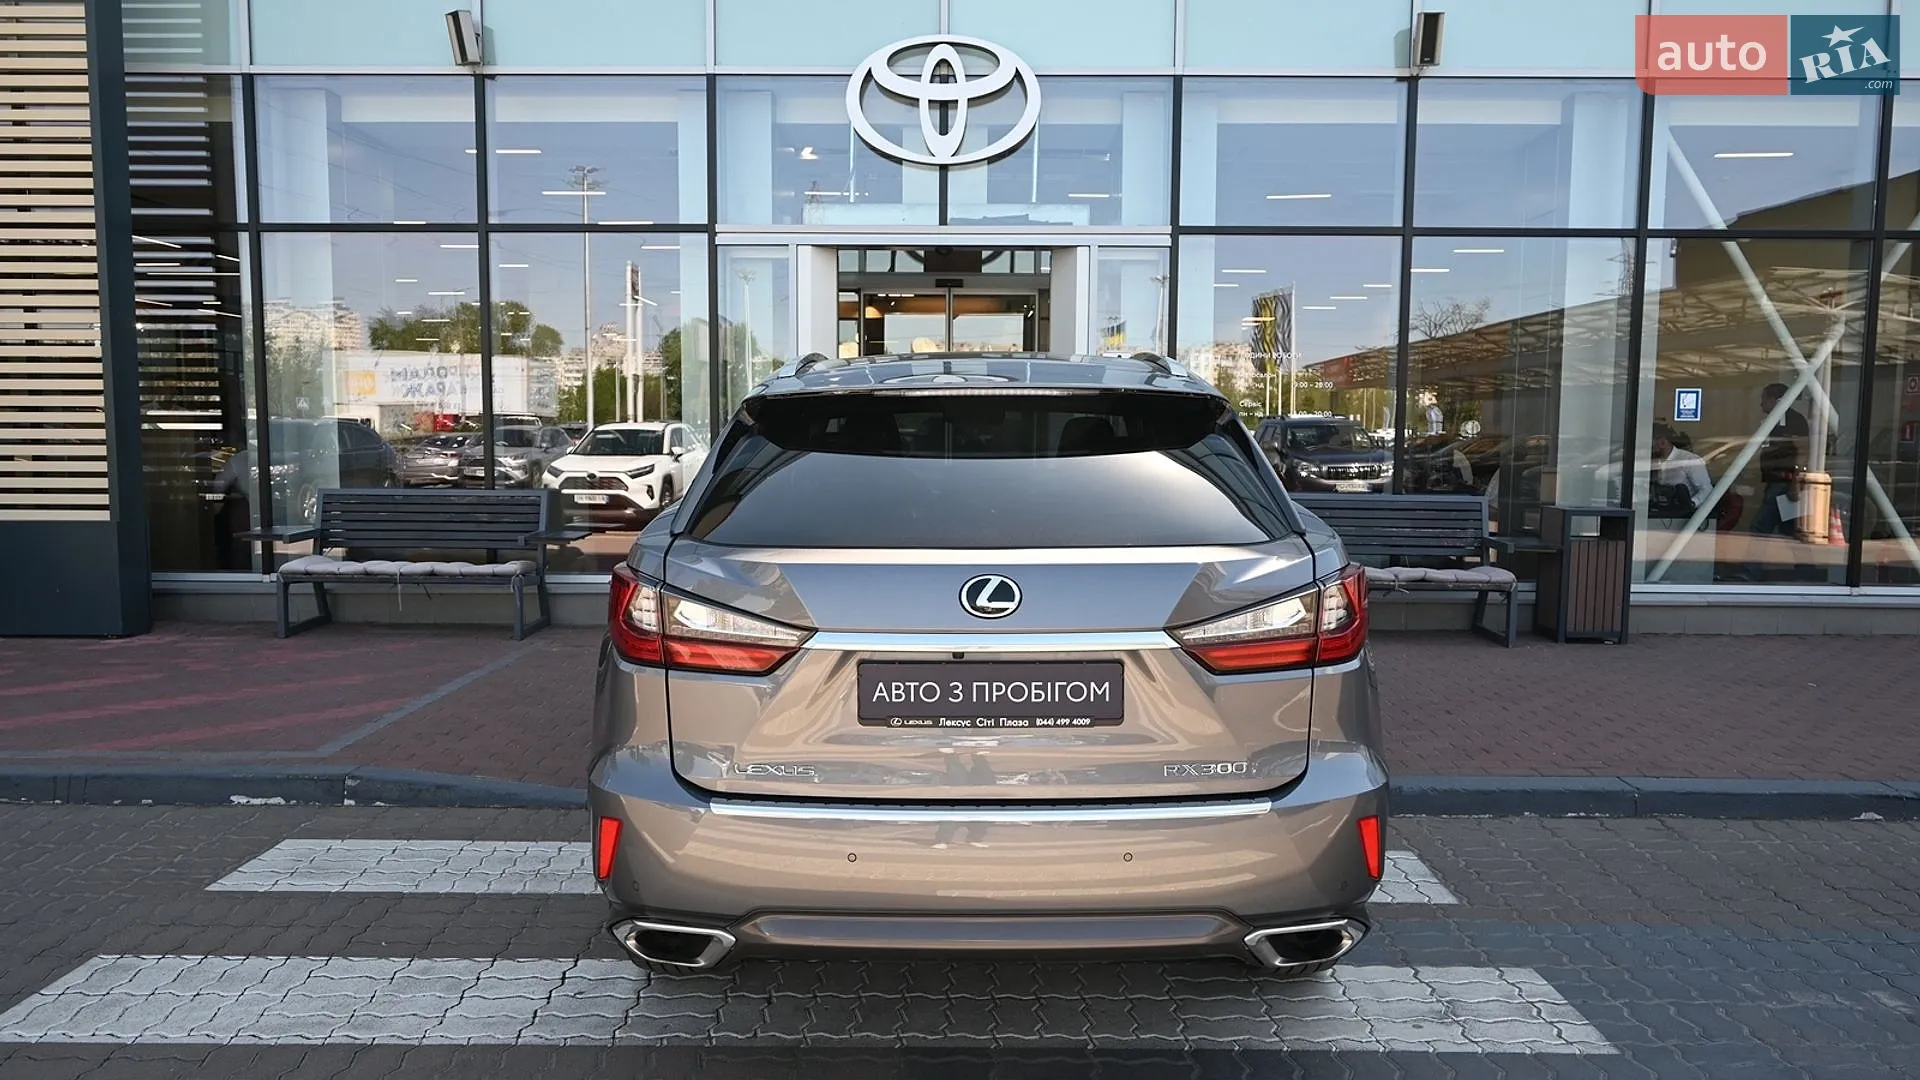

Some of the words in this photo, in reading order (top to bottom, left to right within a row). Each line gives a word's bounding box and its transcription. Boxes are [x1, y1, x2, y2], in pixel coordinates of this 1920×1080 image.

[872, 681, 941, 703] АВТО
[972, 681, 1110, 703] ПРОБІГОМ
[938, 717, 972, 727] Лексус
[1000, 717, 1029, 727] Плаза
[1035, 717, 1055, 727] (044)
[1055, 718, 1070, 726] 499
[1072, 718, 1091, 726] 4009
[734, 763, 816, 777] LEXUS
